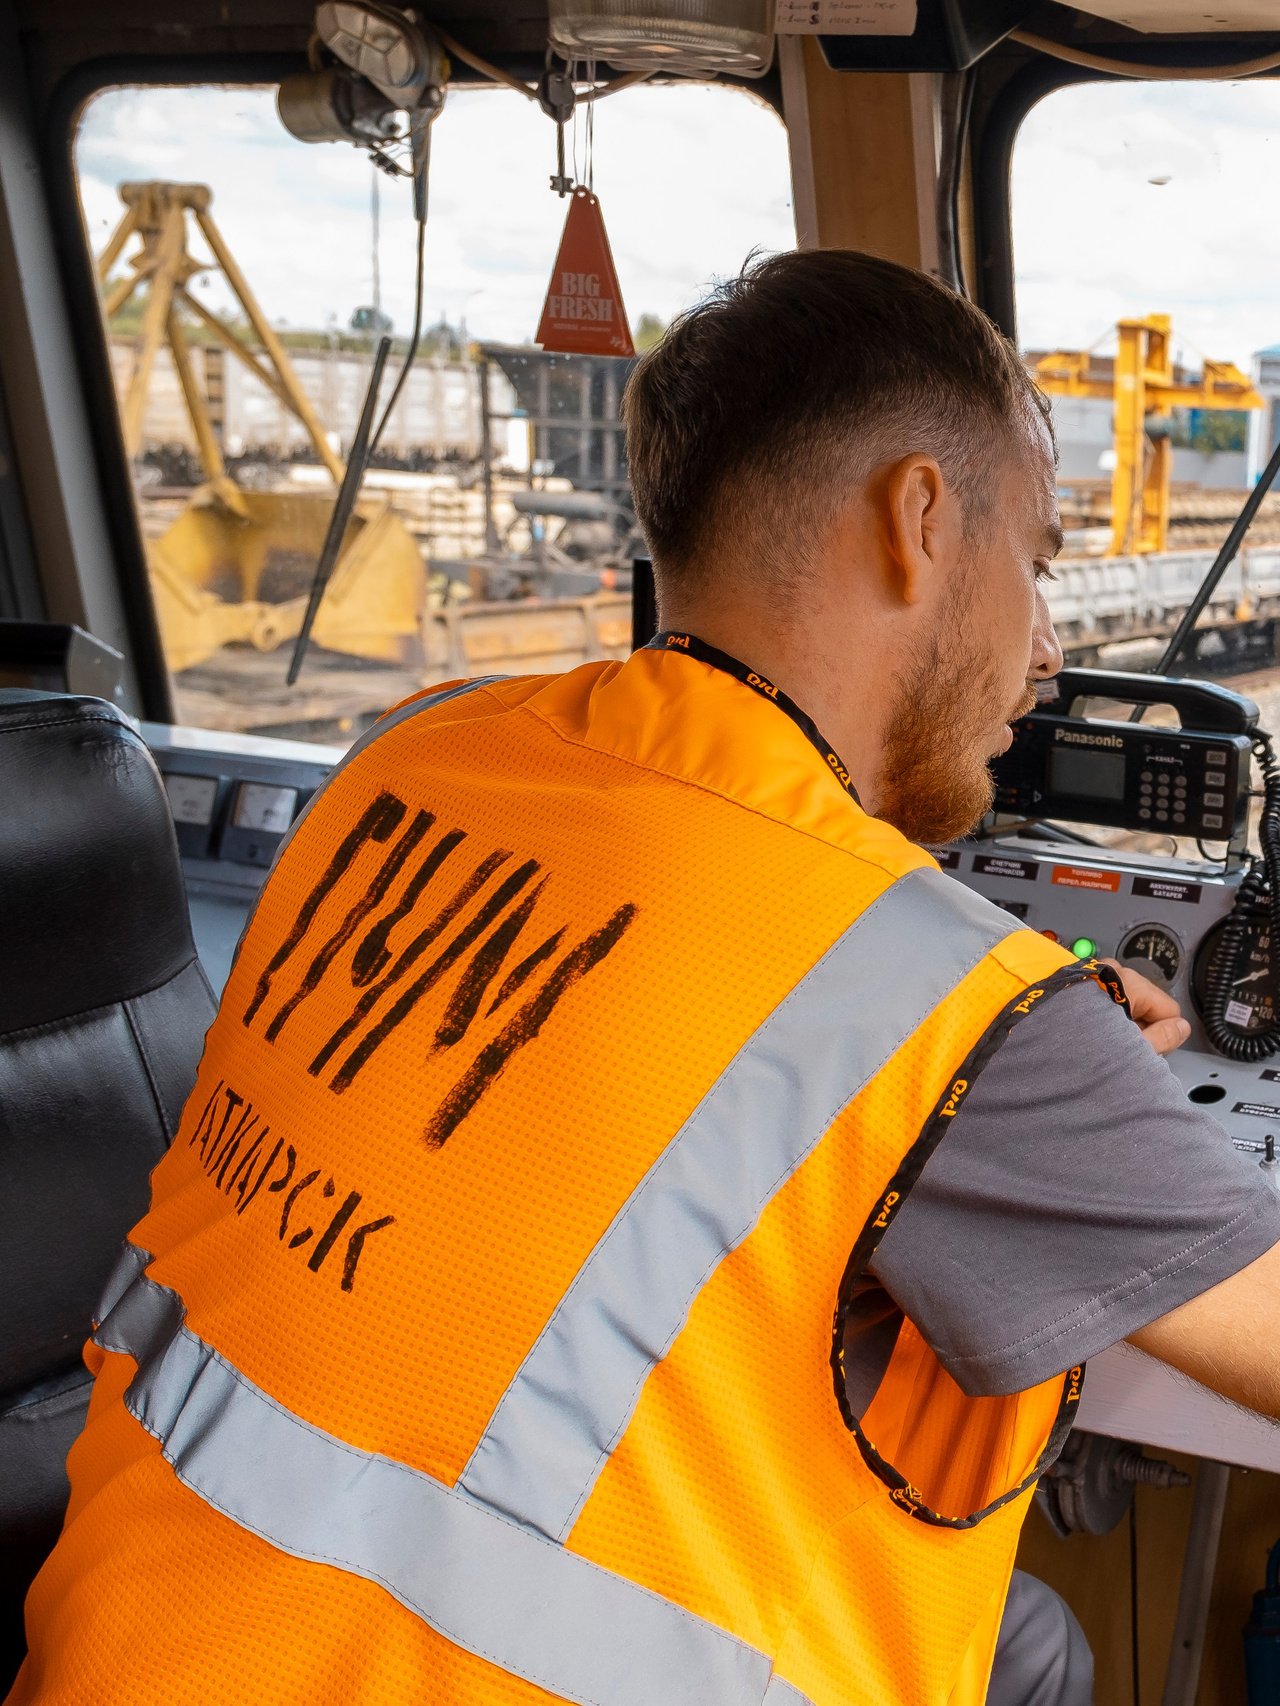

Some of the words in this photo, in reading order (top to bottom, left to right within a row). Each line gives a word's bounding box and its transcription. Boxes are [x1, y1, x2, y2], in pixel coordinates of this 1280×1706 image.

[561, 272, 600, 297] BIG
[548, 295, 614, 322] FRESH
[1055, 728, 1124, 748] Panasonic
[1250, 951, 1270, 964] km/h
[1242, 1104, 1275, 1113] ФОНАРИ
